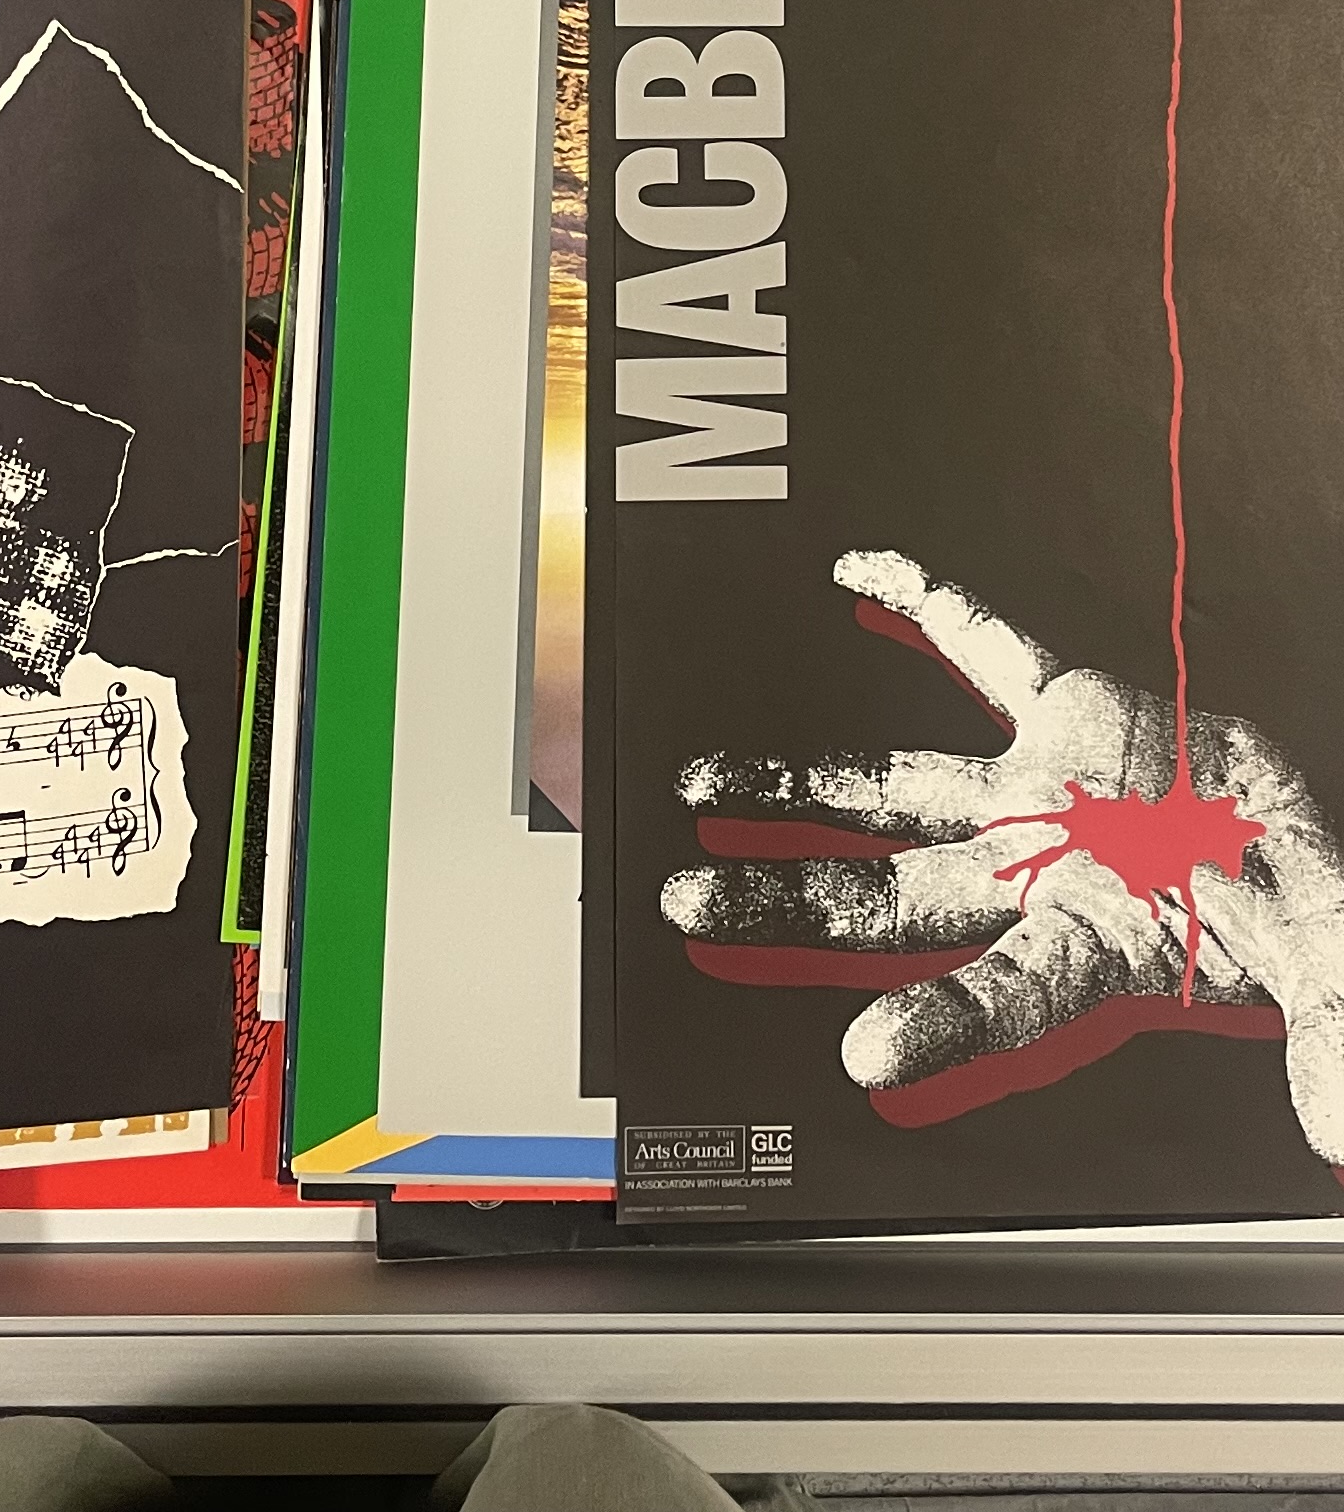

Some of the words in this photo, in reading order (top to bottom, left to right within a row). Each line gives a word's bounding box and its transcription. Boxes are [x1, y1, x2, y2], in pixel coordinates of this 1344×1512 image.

[635, 1143, 670, 1160] Arts
[674, 1140, 735, 1159] Council
[751, 1133, 792, 1152] GLC
[752, 1153, 792, 1164] funded
[636, 1179, 695, 1189] ASSOCIATION
[697, 1179, 720, 1188] WITH
[768, 1178, 792, 1187] BANK
